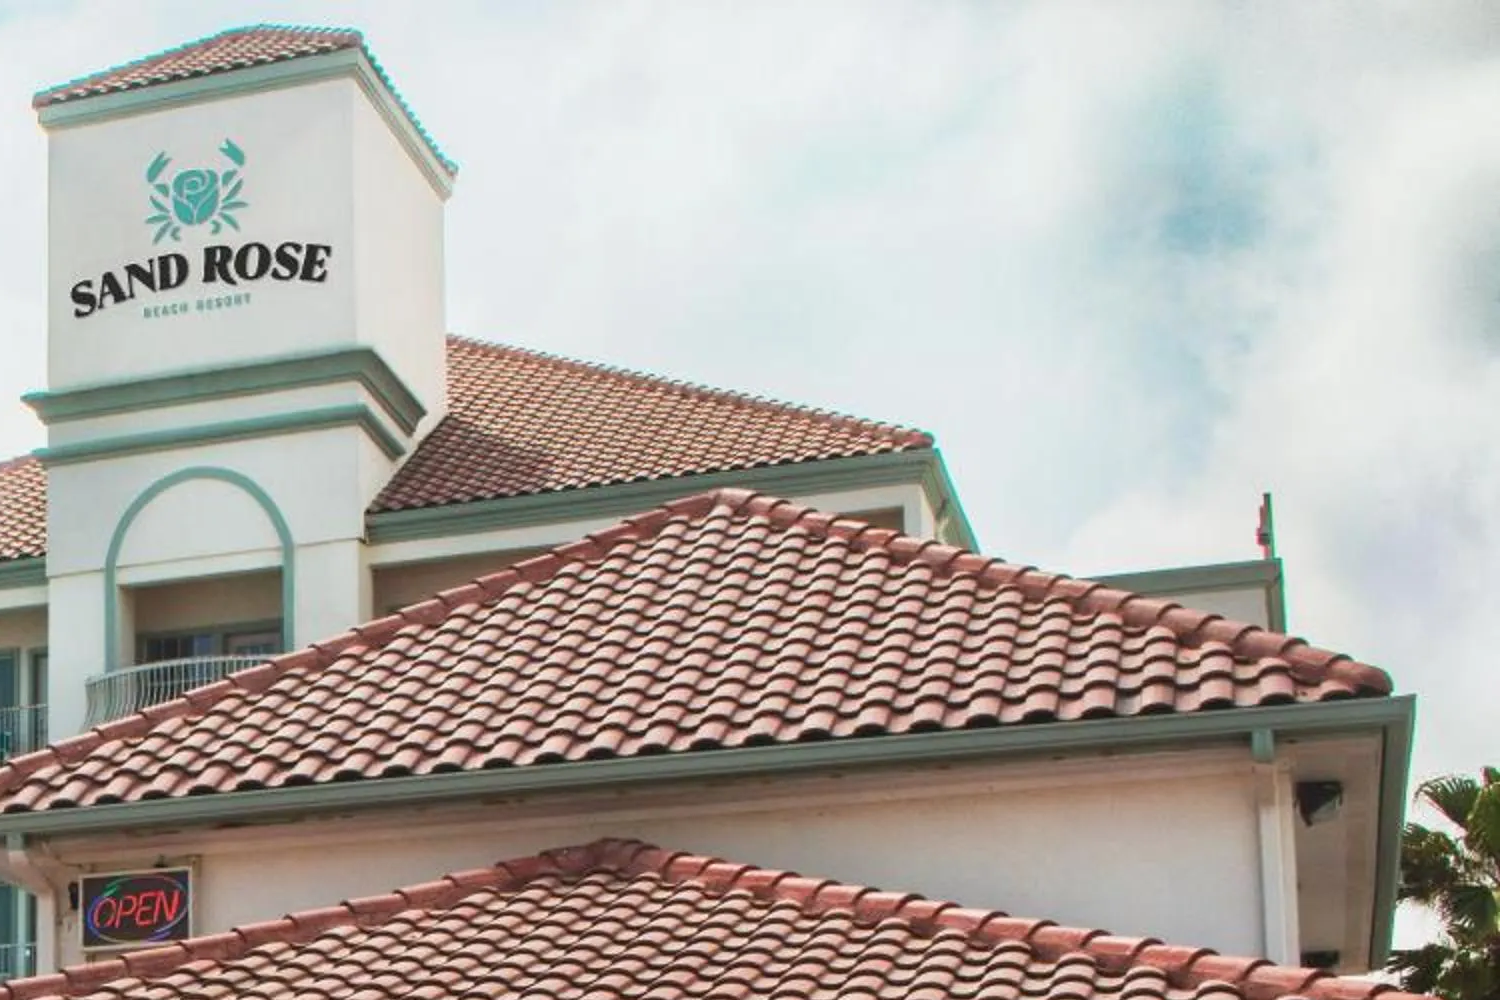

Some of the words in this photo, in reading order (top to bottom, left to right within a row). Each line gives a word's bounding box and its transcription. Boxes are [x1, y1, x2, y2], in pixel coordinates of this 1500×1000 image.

[70, 253, 189, 318] SAND
[202, 242, 332, 285] ROSE
[143, 302, 189, 318] BEACH
[196, 292, 251, 311] RESORT
[92, 889, 180, 928] OPEN
